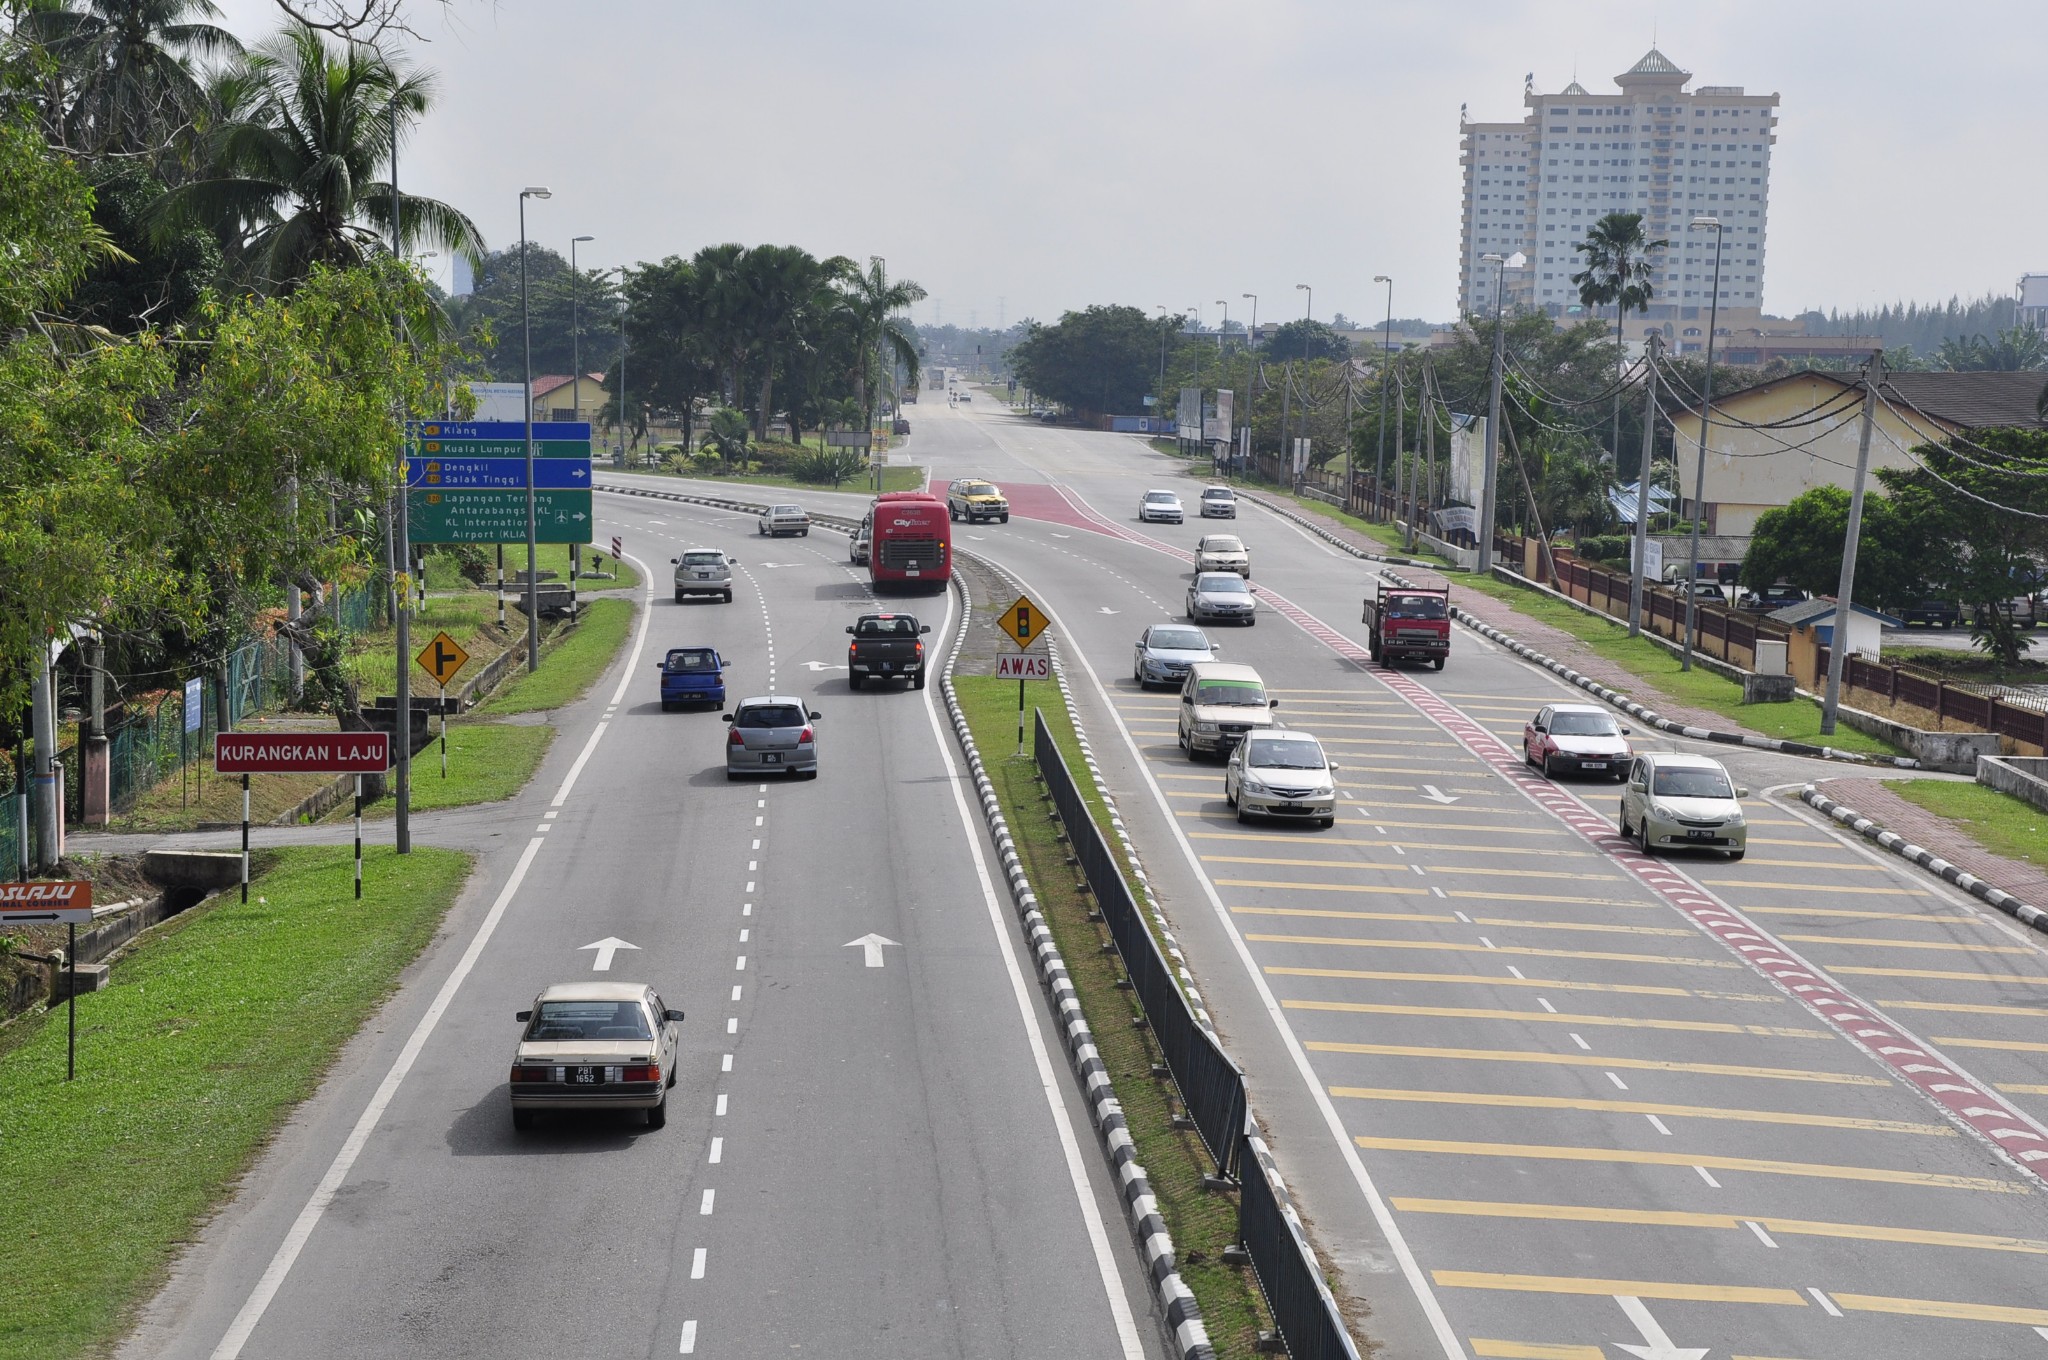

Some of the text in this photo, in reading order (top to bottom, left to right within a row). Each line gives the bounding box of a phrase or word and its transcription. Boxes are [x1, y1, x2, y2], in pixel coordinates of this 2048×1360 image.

[444, 426, 476, 437] Klang
[444, 445, 521, 455] Kuala Lumpur
[444, 463, 488, 473] Dengkil
[445, 475, 519, 485] Salak Tinggi
[445, 494, 501, 504] Lapangan
[537, 507, 551, 515] KL
[445, 518, 459, 526] KL
[452, 530, 494, 540] Airport
[999, 657, 1047, 676] AWAS
[221, 745, 383, 761] KURANGKAN LAJU
[26, 899, 70, 907] COURIER
